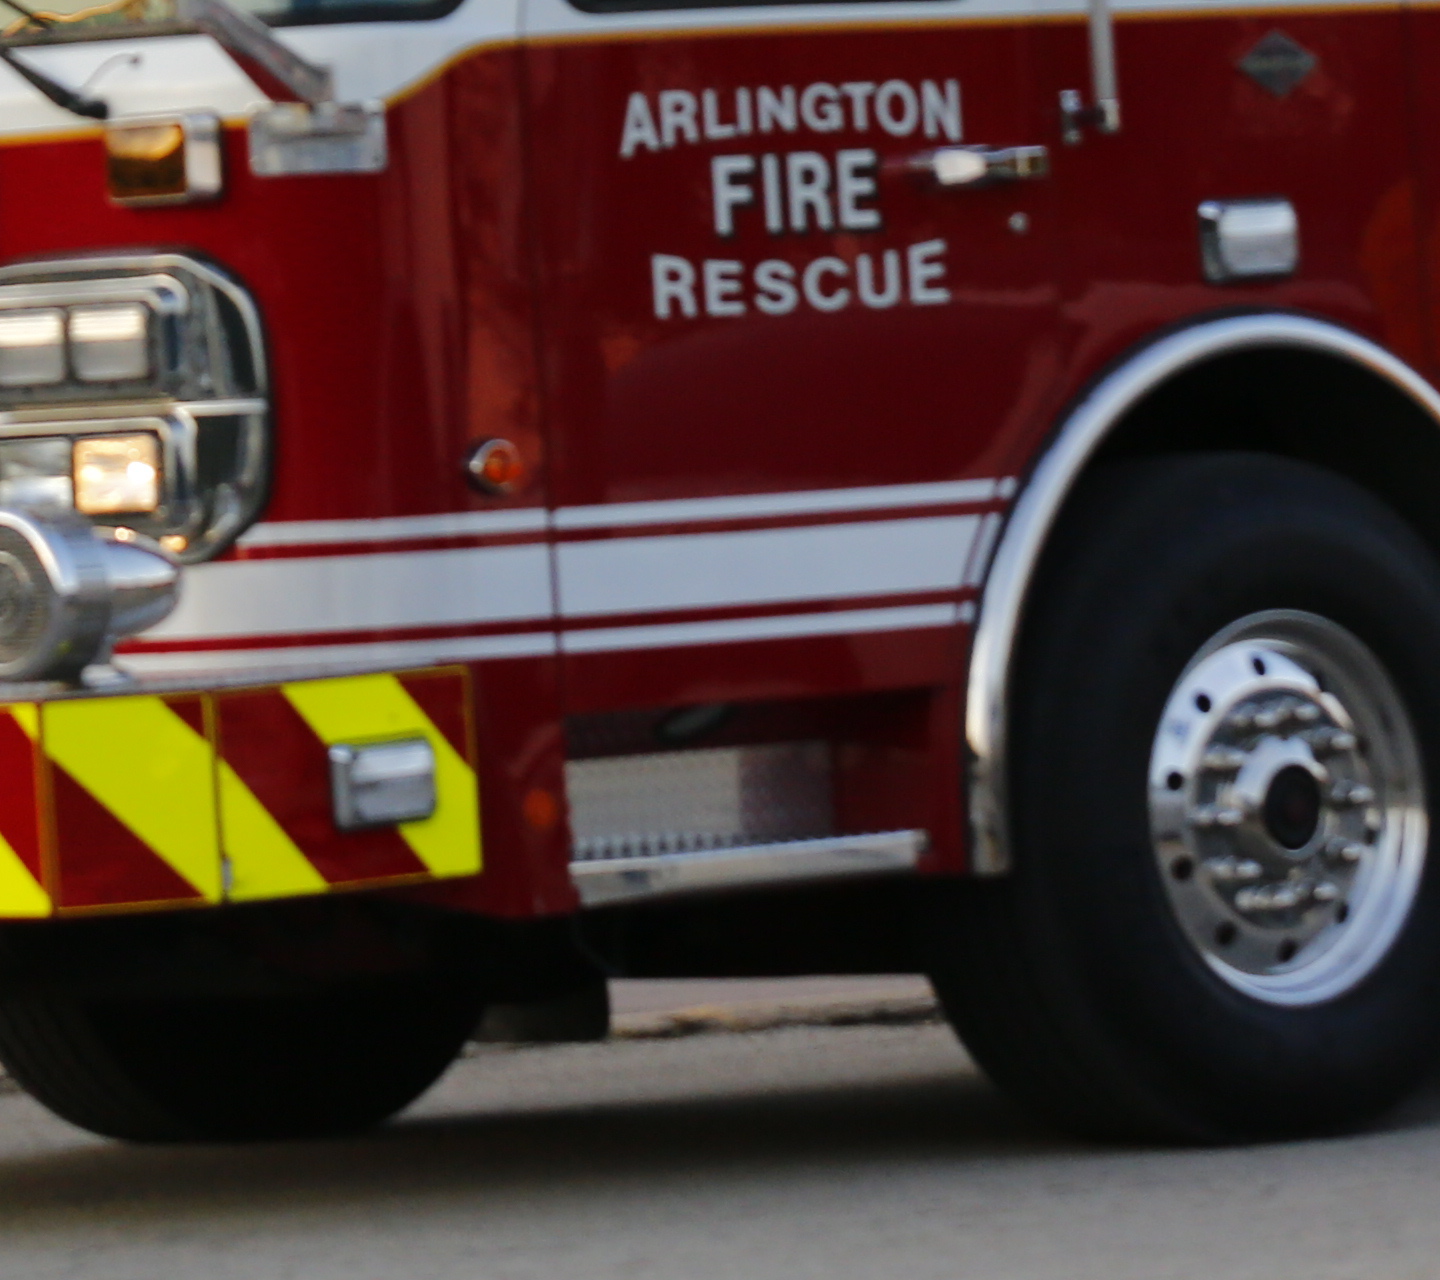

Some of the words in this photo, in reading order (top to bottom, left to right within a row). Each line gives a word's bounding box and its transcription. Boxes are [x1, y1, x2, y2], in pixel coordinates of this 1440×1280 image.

[619, 79, 963, 158] ARLINGTON
[711, 148, 882, 237] FIRE
[650, 238, 952, 320] RESCUE
